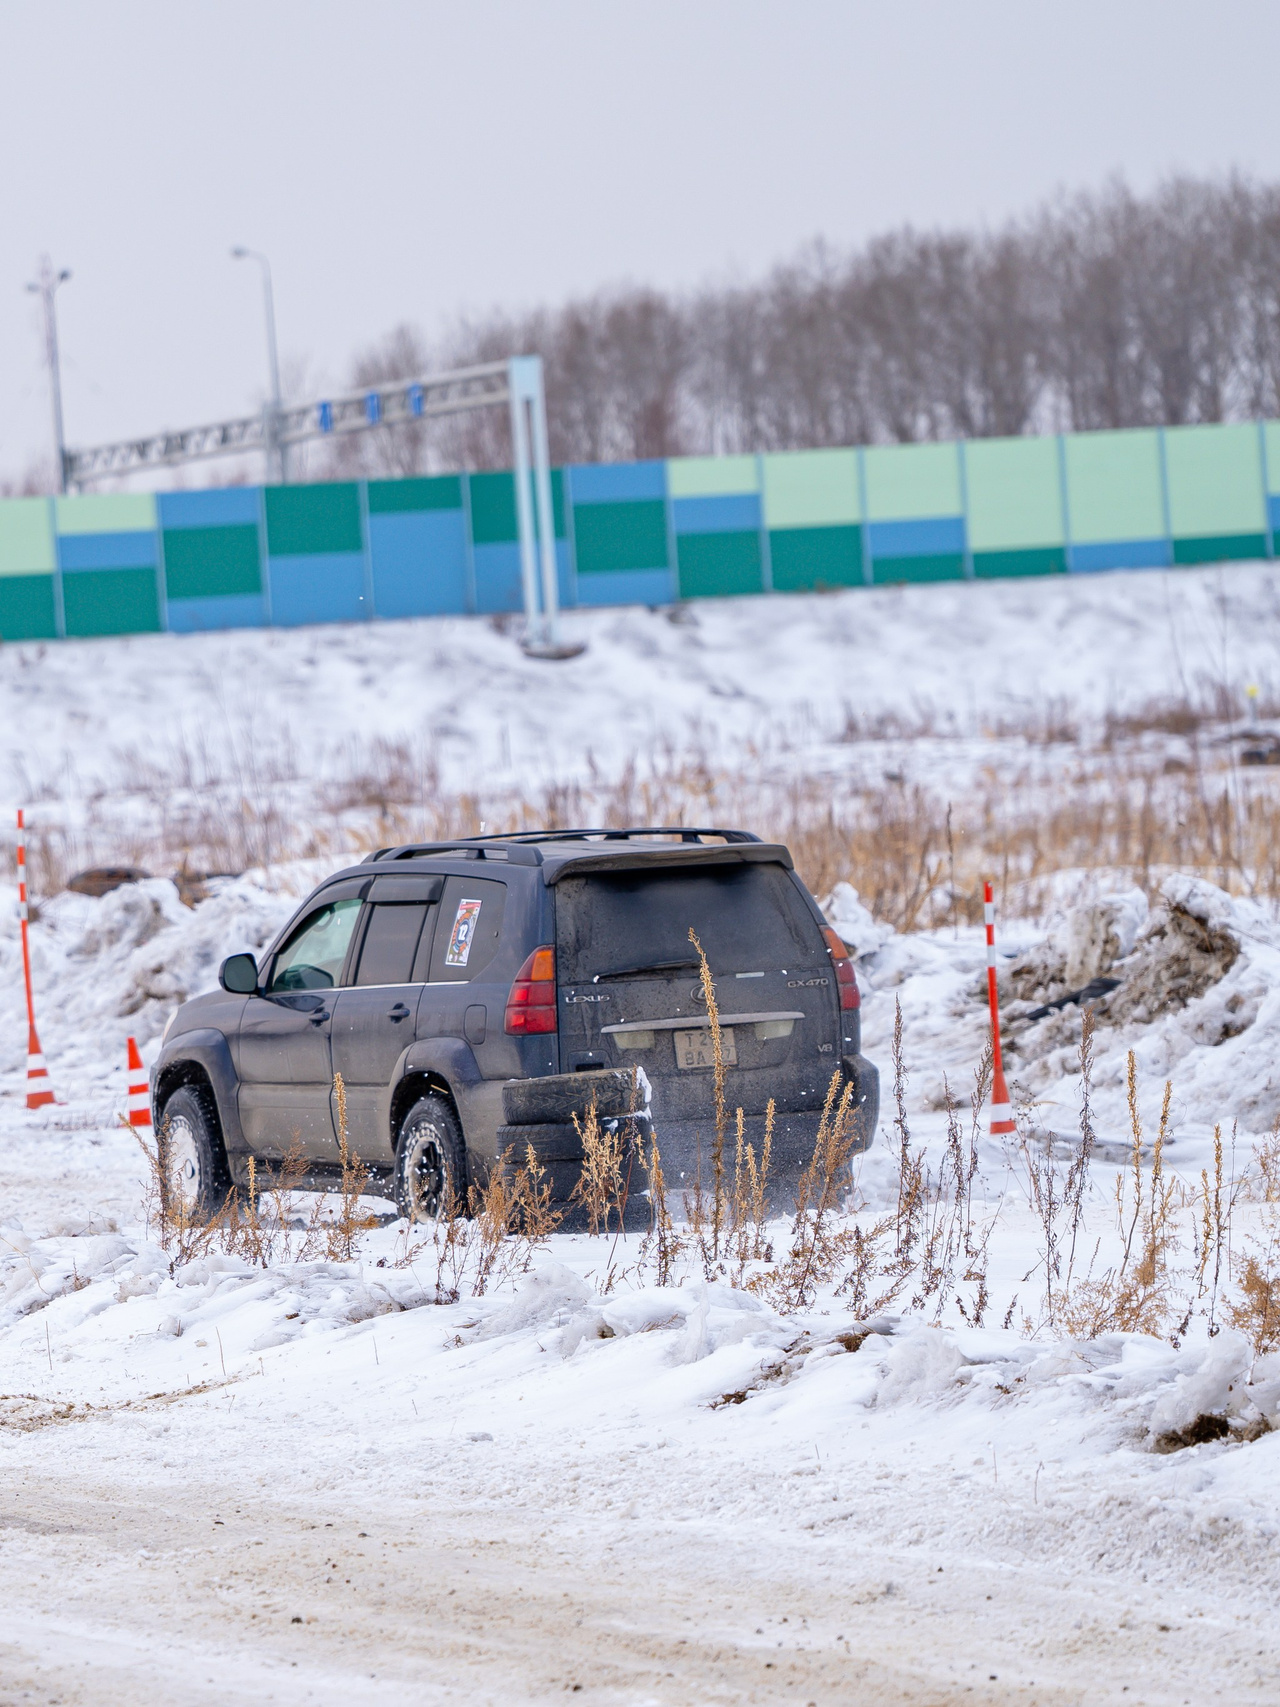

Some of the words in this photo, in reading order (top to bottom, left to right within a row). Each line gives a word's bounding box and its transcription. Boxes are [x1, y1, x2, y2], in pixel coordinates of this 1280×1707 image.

[458, 924, 469, 941] 12
[565, 994, 610, 1004] LEXUS
[817, 1043, 833, 1053] V8
